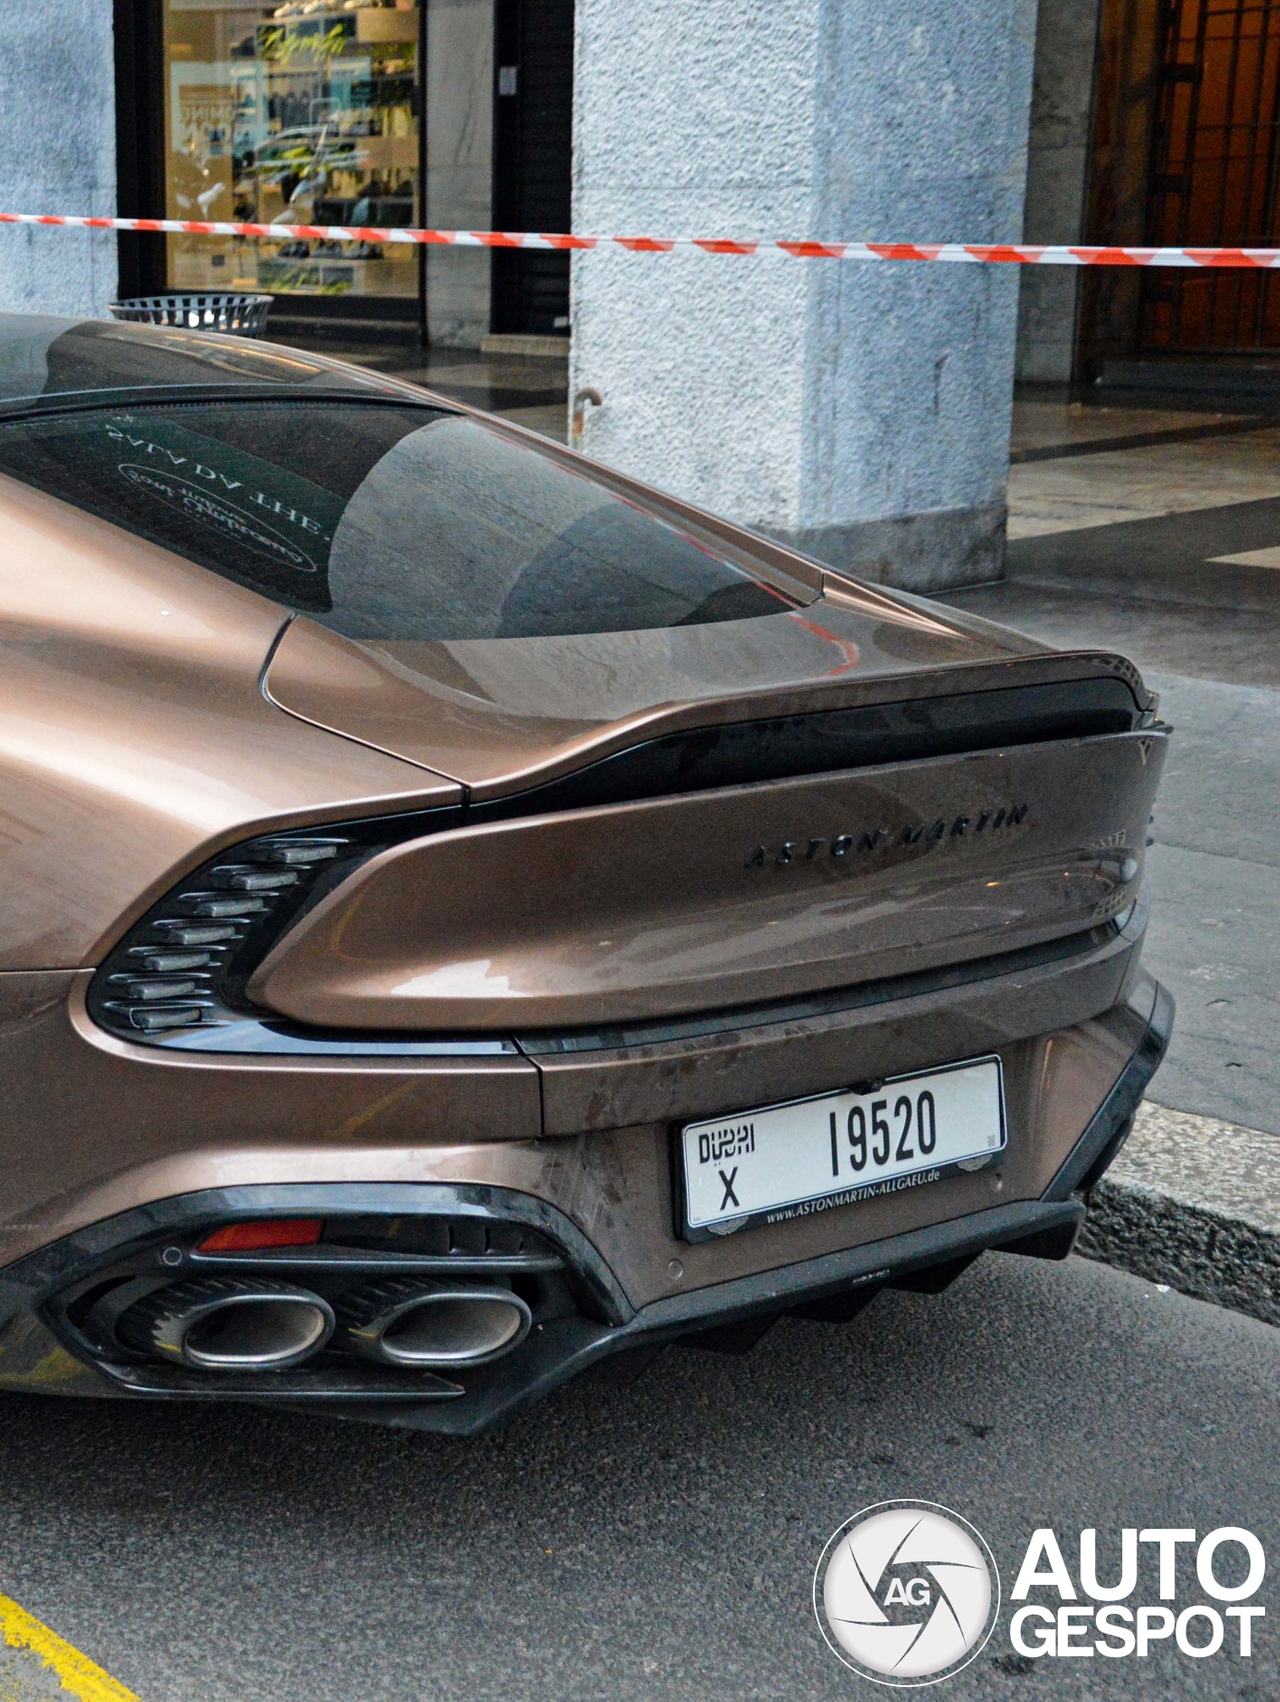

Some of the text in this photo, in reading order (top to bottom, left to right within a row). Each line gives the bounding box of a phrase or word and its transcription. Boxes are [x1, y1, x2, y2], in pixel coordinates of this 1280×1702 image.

[744, 803, 1029, 869] ASTON MARTIN
[829, 1090, 937, 1177] 19520
[718, 1166, 740, 1211] X
[767, 1169, 940, 1224] www.ASTONMARTIN-ALLGAEU.de
